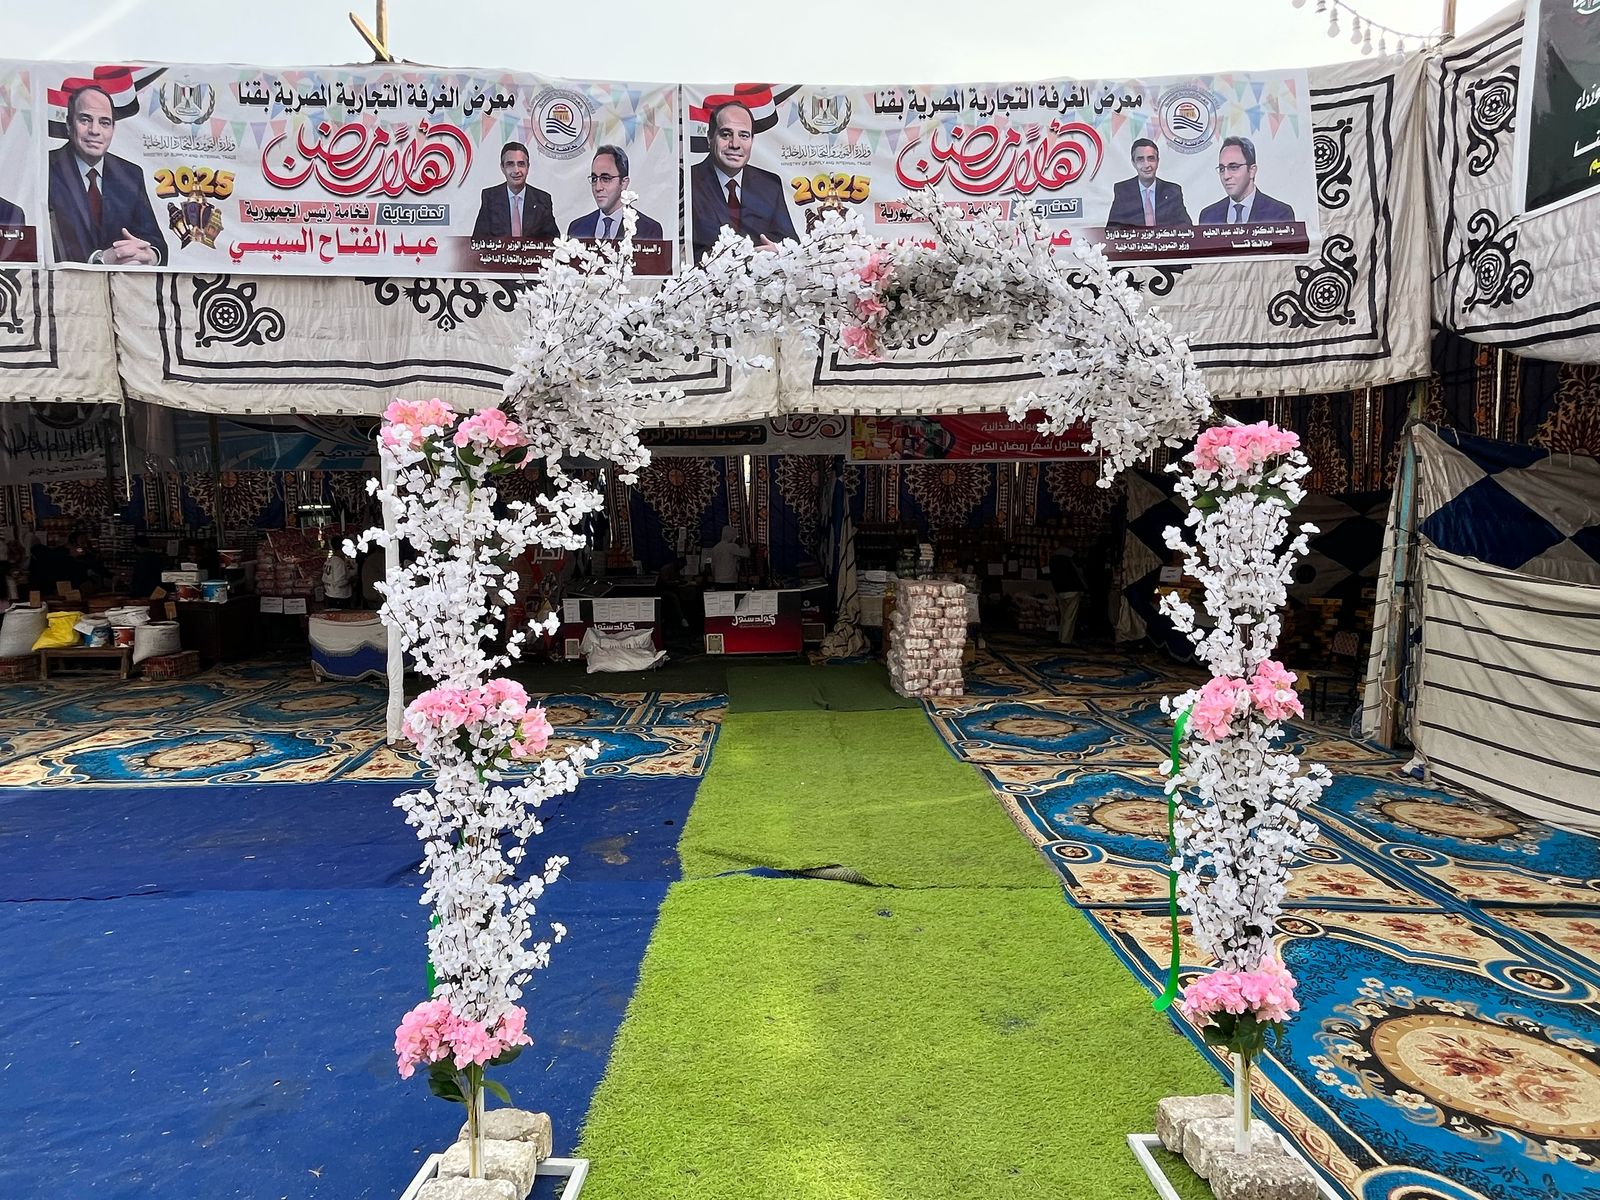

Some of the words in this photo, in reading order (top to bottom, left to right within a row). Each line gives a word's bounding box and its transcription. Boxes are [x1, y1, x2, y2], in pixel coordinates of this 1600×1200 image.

[239, 81, 270, 113] بقنا
[274, 81, 331, 113] المصرية
[336, 81, 402, 115] التجارية
[407, 83, 459, 115] الغرفة
[464, 85, 515, 116] معرض
[874, 90, 904, 120] بقنا
[908, 88, 965, 119] المصرية
[969, 85, 1034, 117] التجارية
[1038, 85, 1090, 114] الغرفة
[1094, 85, 1143, 114] معرض
[154, 166, 236, 200] 2025
[791, 172, 871, 206] 2025
[246, 201, 300, 223] الجمهورية
[303, 204, 333, 223] رئيس
[335, 202, 370, 220] فخامة
[382, 203, 416, 223] رعاية
[418, 203, 445, 220] تحت
[1050, 198, 1078, 214] تحت
[1156, 228, 1176, 239] الدكتور
[1202, 227, 1220, 238] الحليم
[1221, 228, 1231, 237] عبد
[1232, 226, 1245, 235] خالد
[1251, 226, 1274, 236] الدكتور
[229, 226, 314, 264] السيسي
[319, 226, 387, 263] الفتاح
[393, 231, 439, 264] عبد
[521, 241, 544, 251] الدكتور
[1115, 242, 1136, 252] الداخلية
[1137, 242, 1157, 251] والتجارة
[1158, 241, 1177, 251] التموين
[971, 441, 997, 455] الكريم
[1000, 441, 1028, 452] رمضان
[1054, 439, 1079, 451] بحلول
